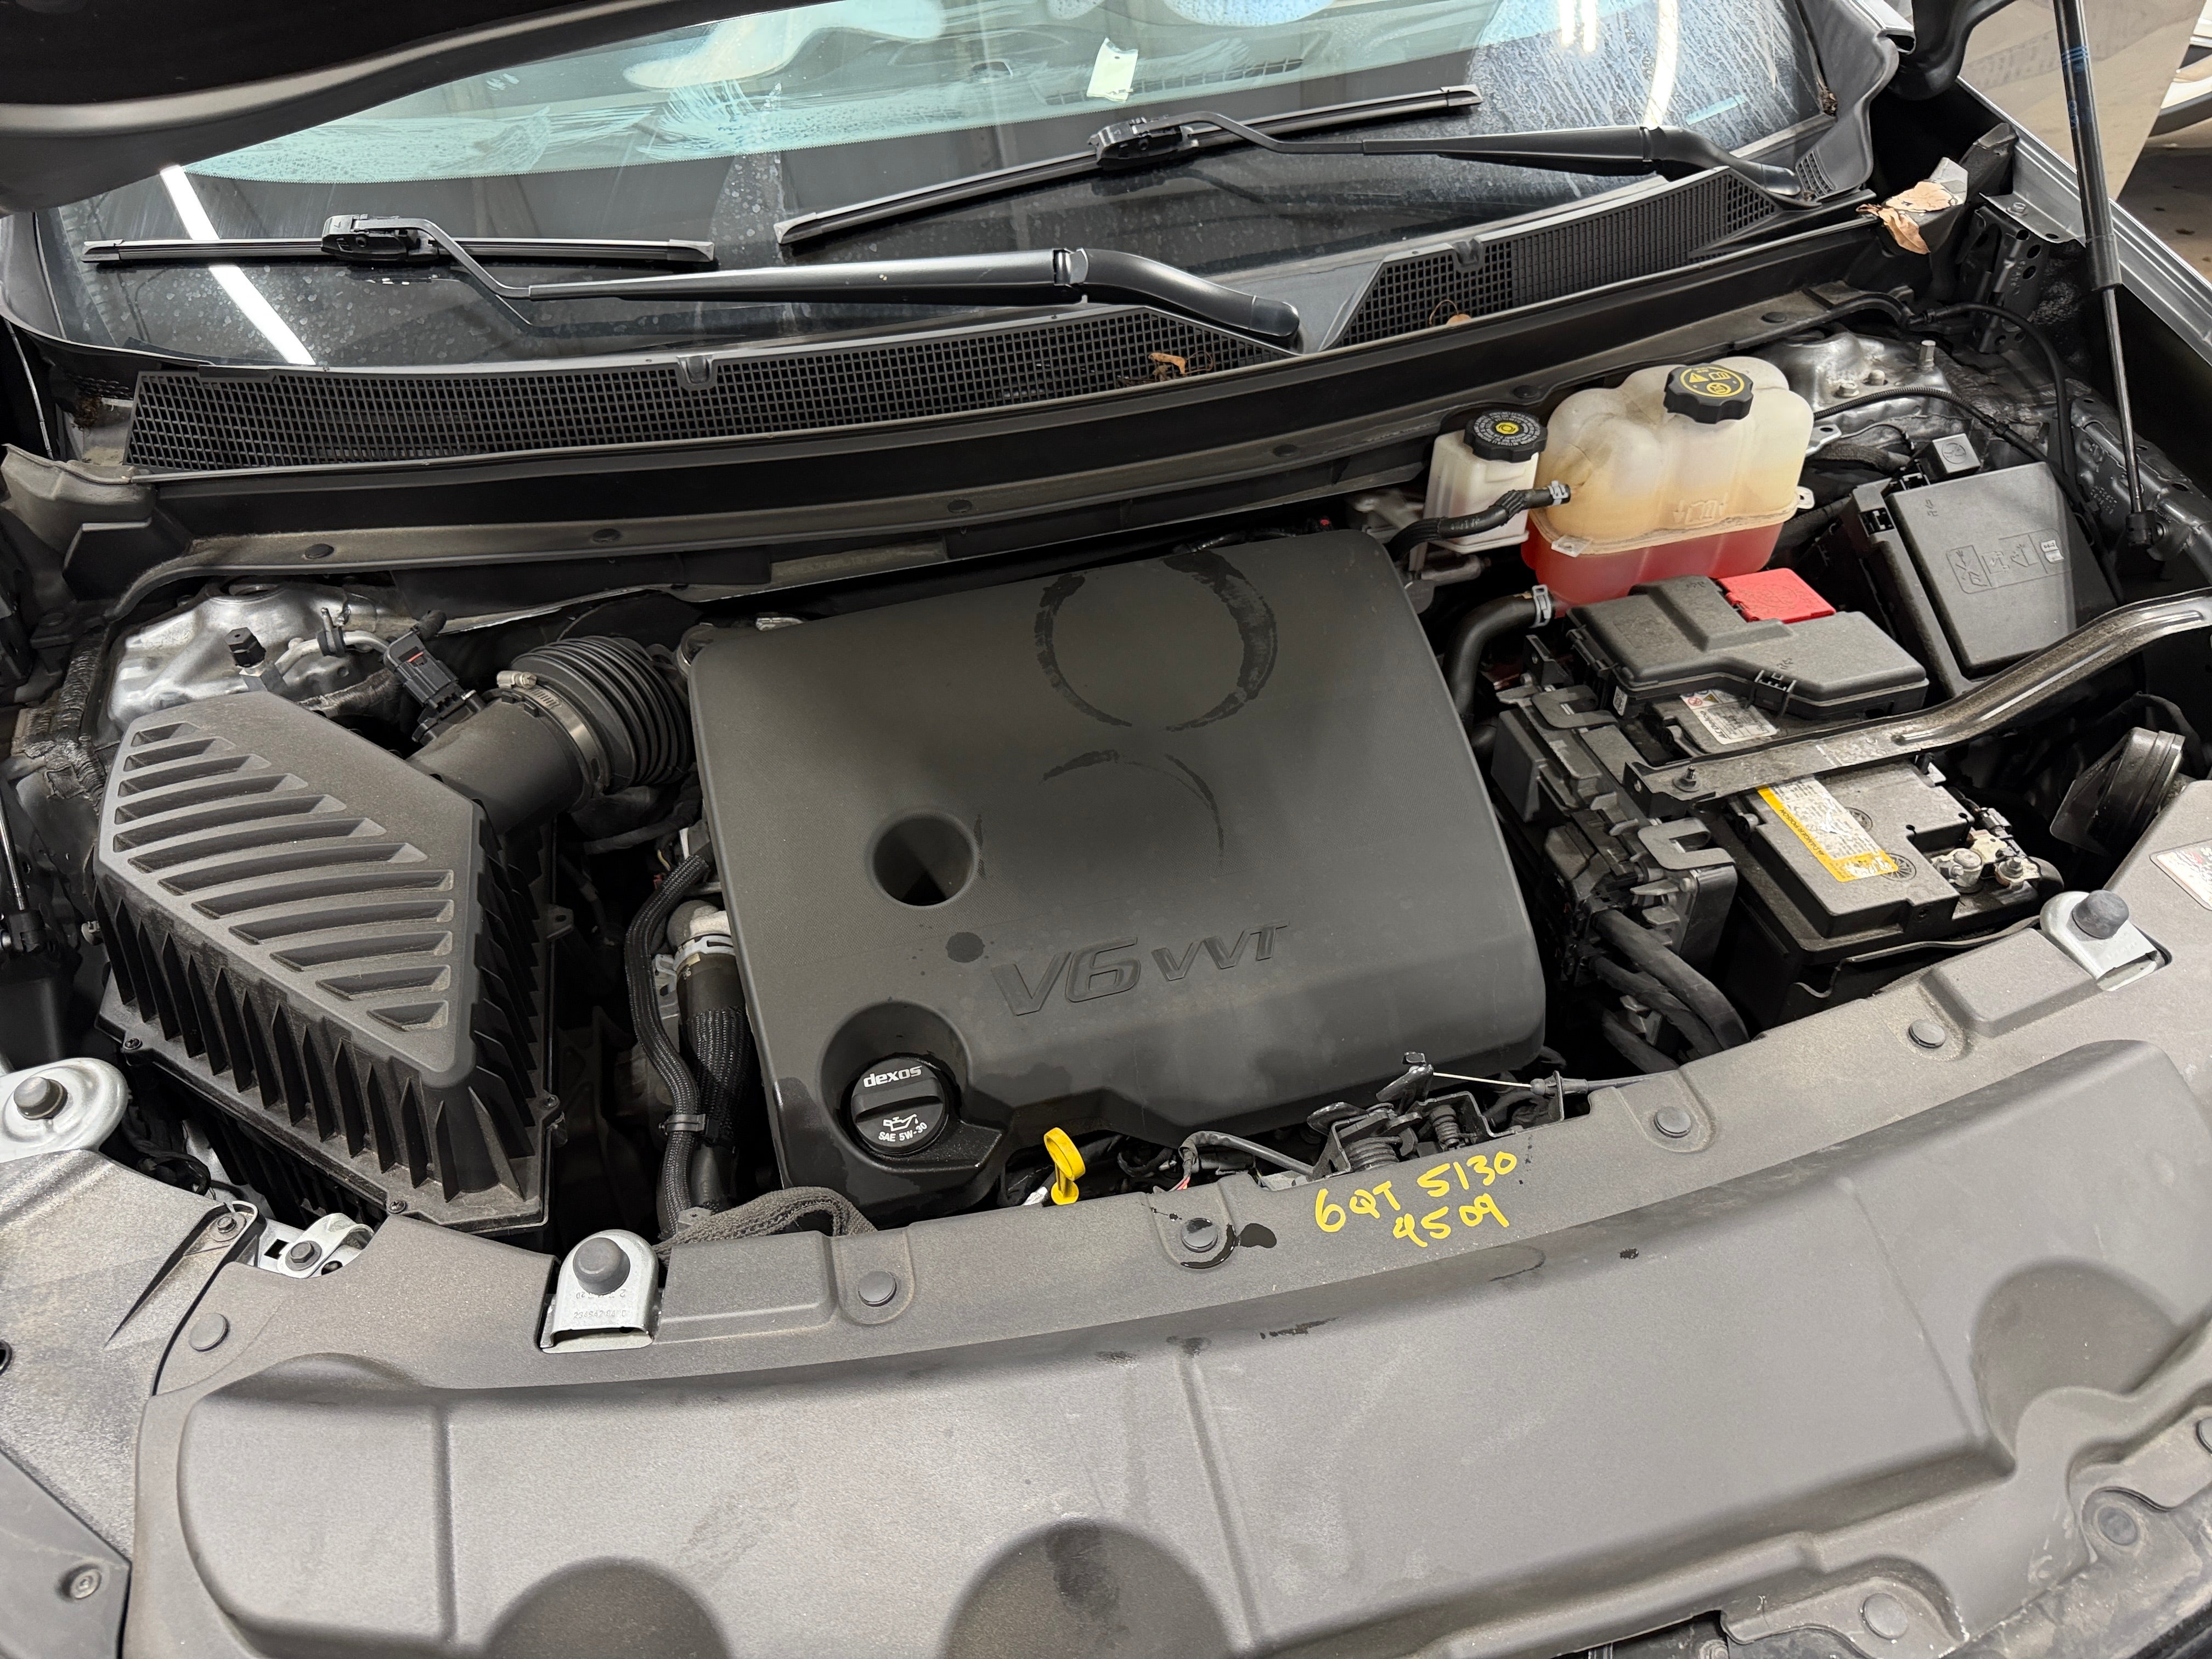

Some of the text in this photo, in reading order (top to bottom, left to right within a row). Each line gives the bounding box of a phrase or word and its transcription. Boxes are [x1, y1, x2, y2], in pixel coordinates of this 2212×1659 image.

[991, 921, 1290, 1016] V6 VVT
[863, 1065, 923, 1088] dexos
[878, 1121, 928, 1142] SAE 5W-30
